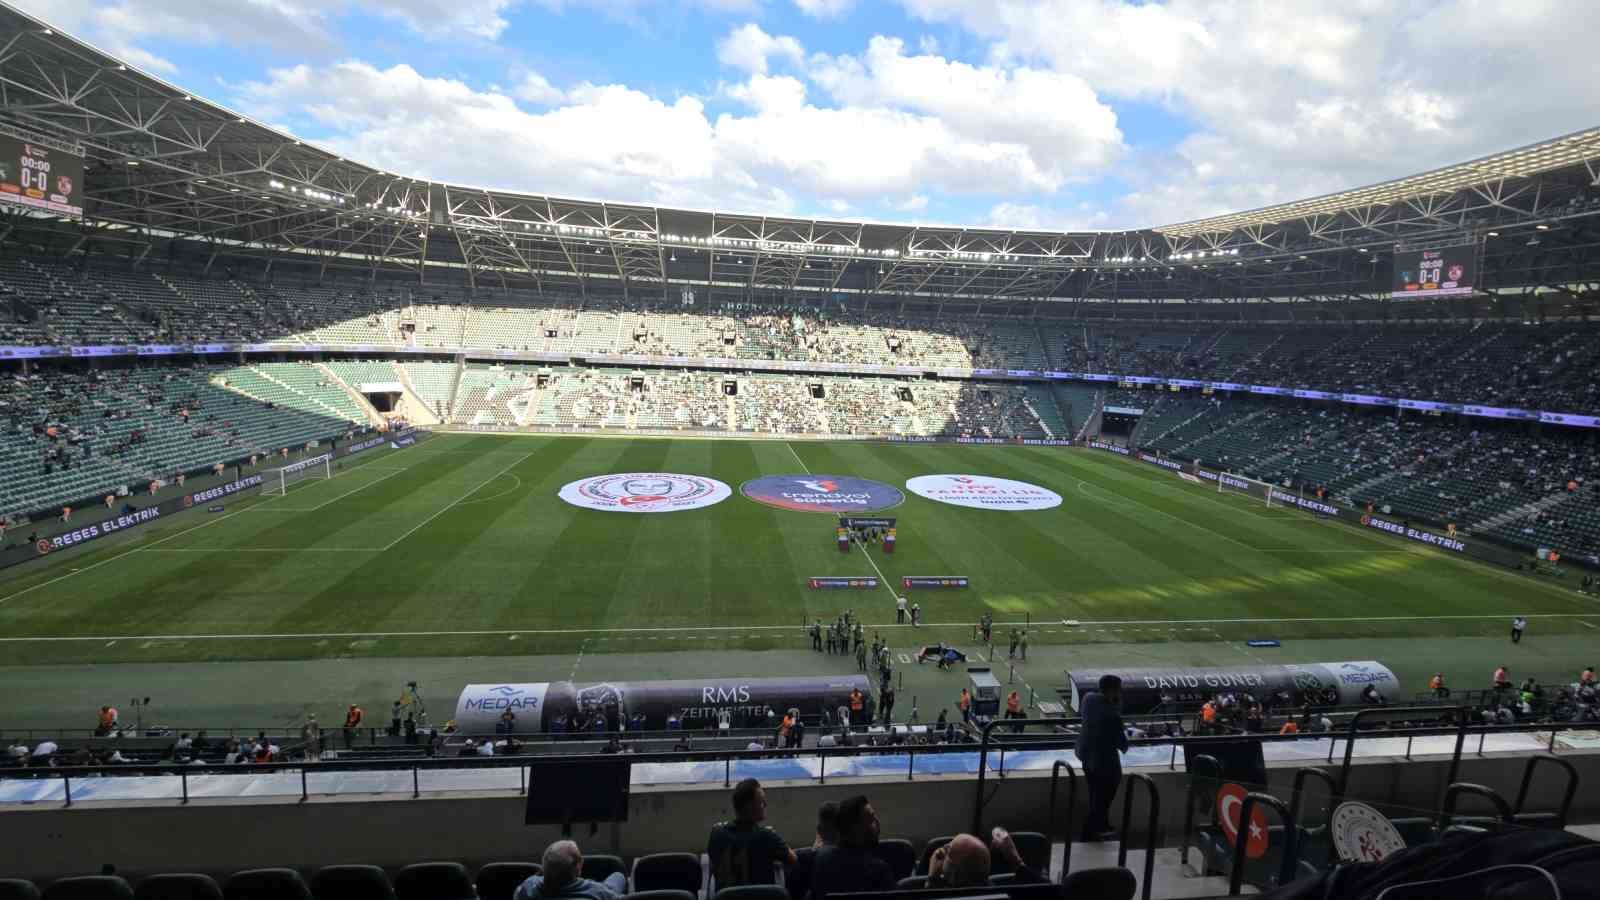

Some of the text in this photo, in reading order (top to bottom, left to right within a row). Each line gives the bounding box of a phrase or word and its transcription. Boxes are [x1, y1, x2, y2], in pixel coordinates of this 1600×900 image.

[20, 155, 50, 172] 00:00
[21, 167, 48, 191] 0-0
[1420, 268, 1440, 284] 0-0
[53, 507, 160, 548] REGES ELEKTRİK
[1370, 518, 1465, 552] REGES ELEKTRİK
[1144, 675, 1199, 688] DAVID
[1342, 672, 1391, 684] MEDAR
[702, 685, 750, 703] RMS
[464, 697, 538, 709] MEDAR
